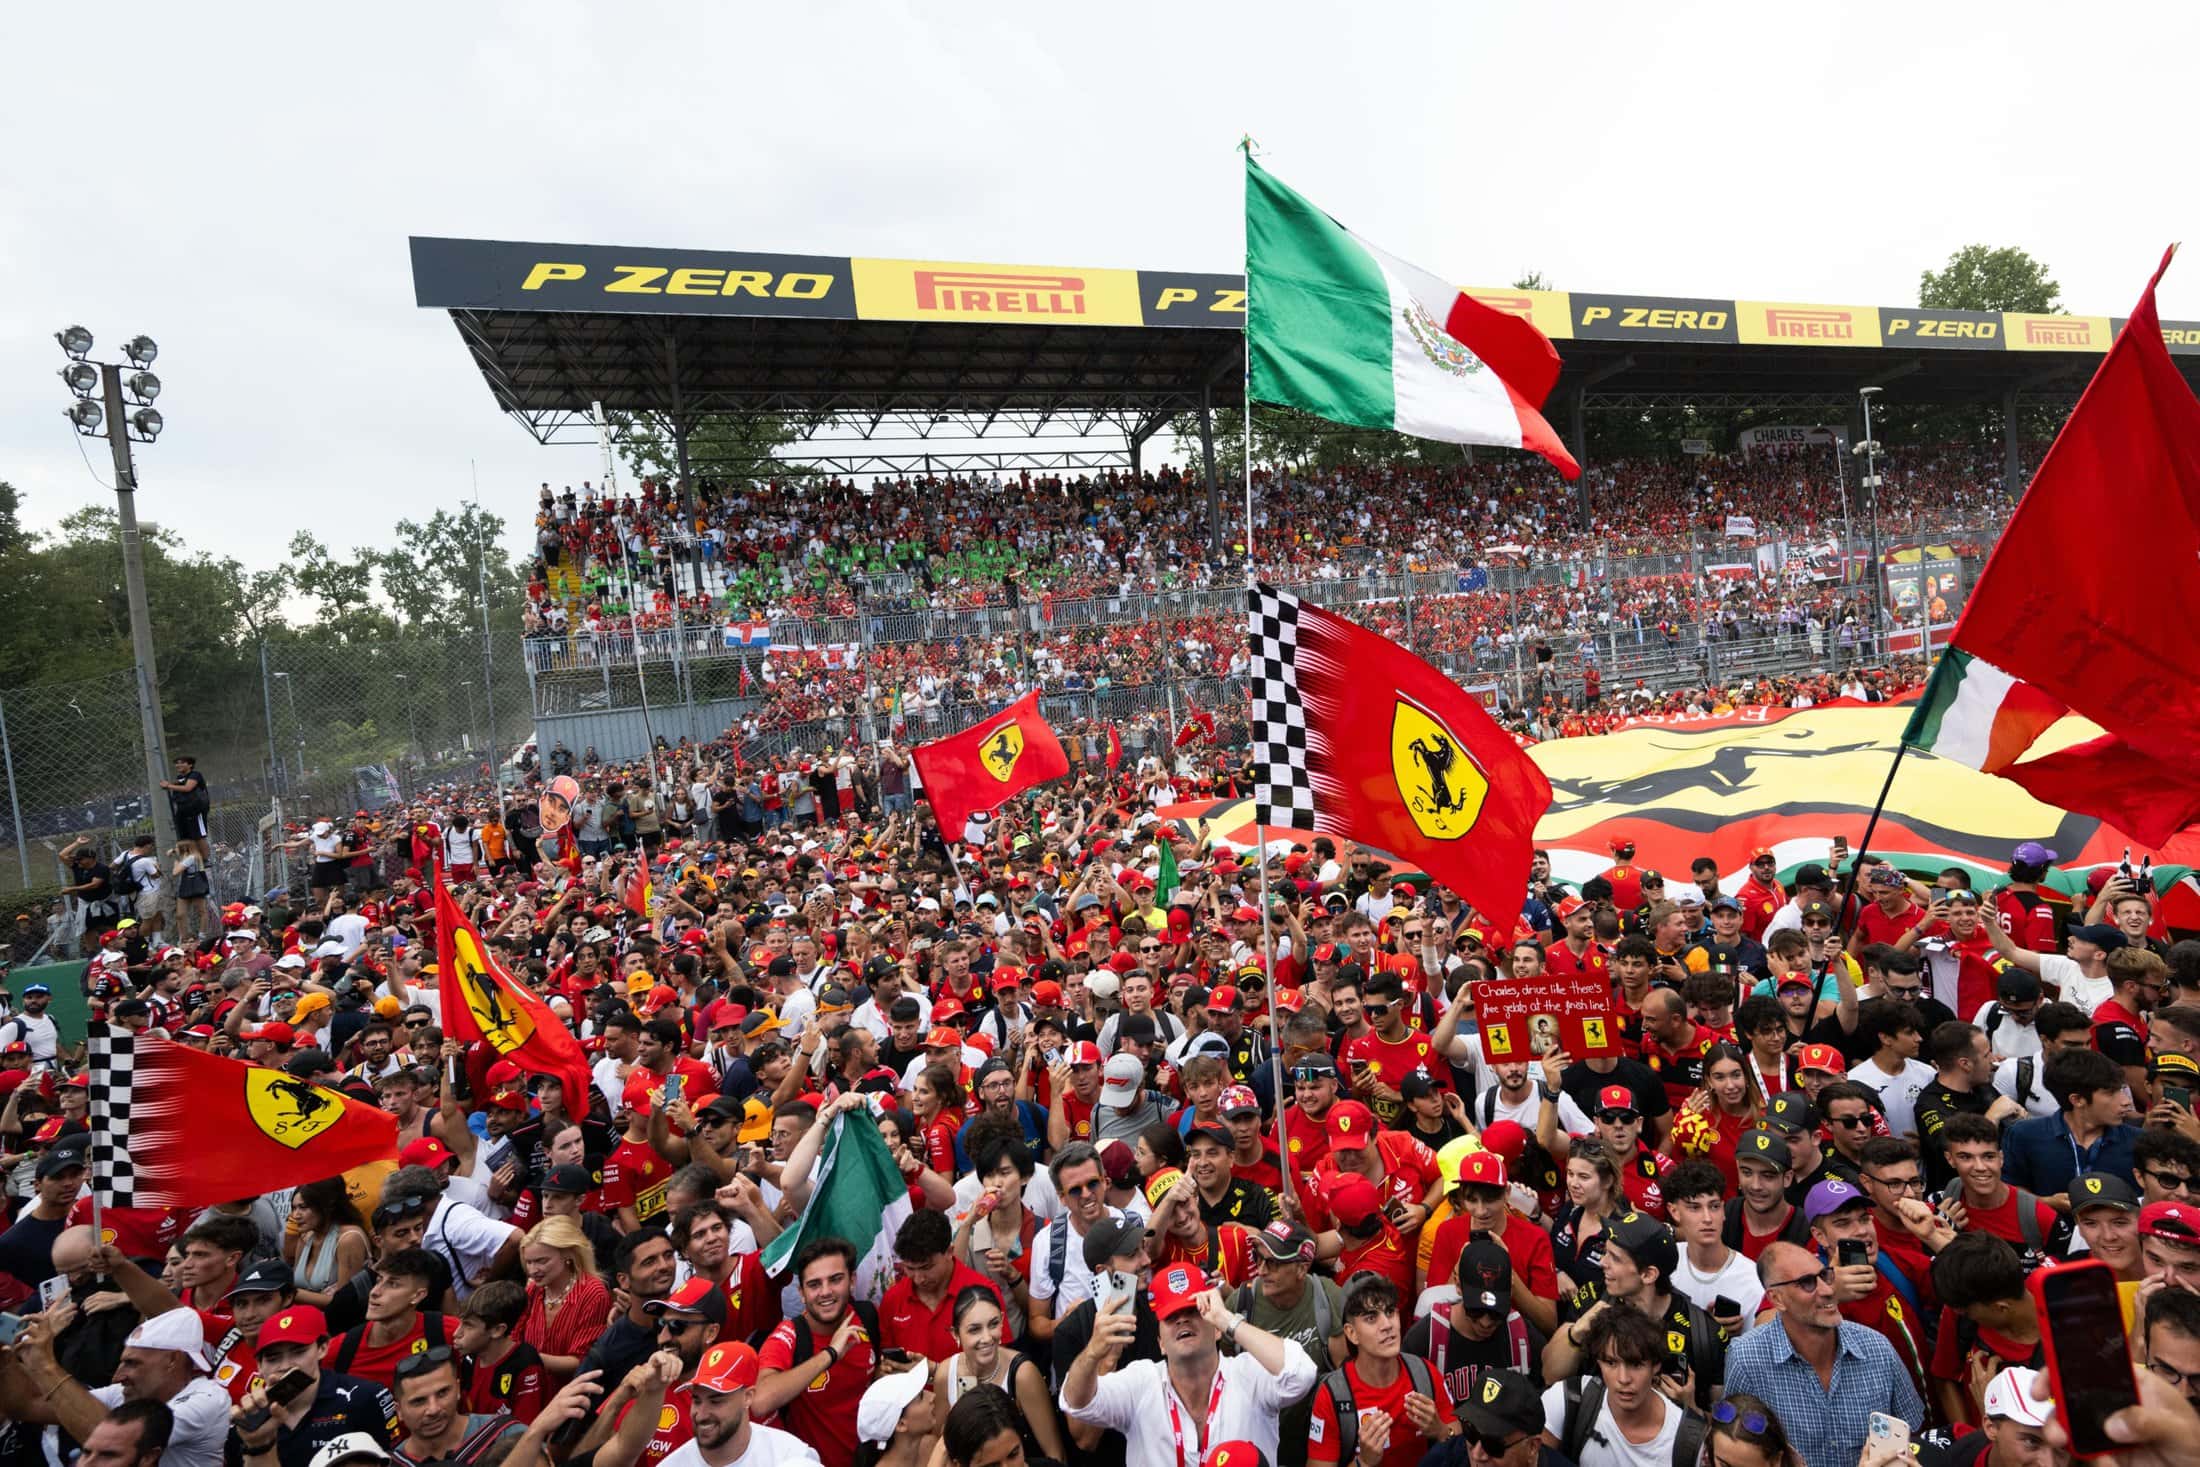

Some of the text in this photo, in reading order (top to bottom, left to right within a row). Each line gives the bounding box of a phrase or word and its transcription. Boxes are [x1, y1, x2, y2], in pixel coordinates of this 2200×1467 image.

[521, 262, 834, 299] P ZERO
[914, 271, 1085, 315] PIRELLI
[1155, 287, 1198, 311] P
[1582, 306, 1728, 330] P ZERO
[1766, 309, 1852, 338] PIRELLI
[1888, 319, 1997, 339] P ZERO
[2025, 319, 2091, 345] PIRELLI
[2160, 329, 2200, 345] ERO
[1754, 428, 1805, 442] CHARLES
[1478, 979, 1603, 998] Charles, drive like there's
[1482, 996, 1610, 1018] free gelato at the finish line!
[274, 1120, 289, 1135] S
